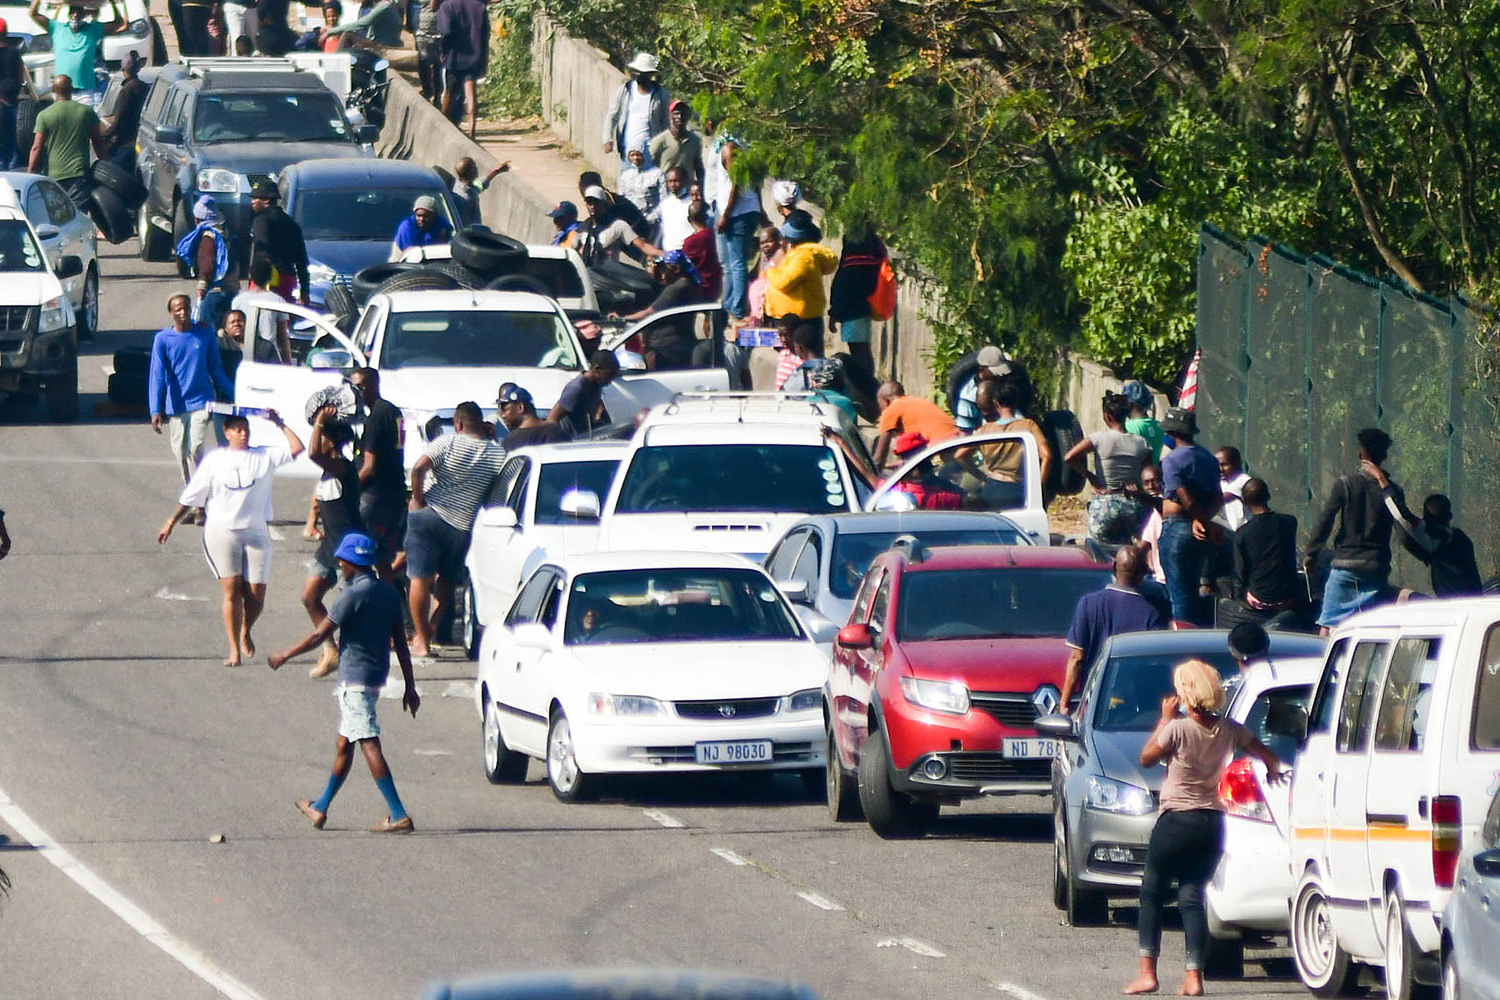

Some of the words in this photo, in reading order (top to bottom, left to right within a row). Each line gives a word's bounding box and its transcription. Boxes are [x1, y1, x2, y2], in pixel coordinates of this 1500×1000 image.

[703, 745, 719, 760] NJ
[727, 743, 766, 760] 98030
[1011, 741, 1028, 757] ND
